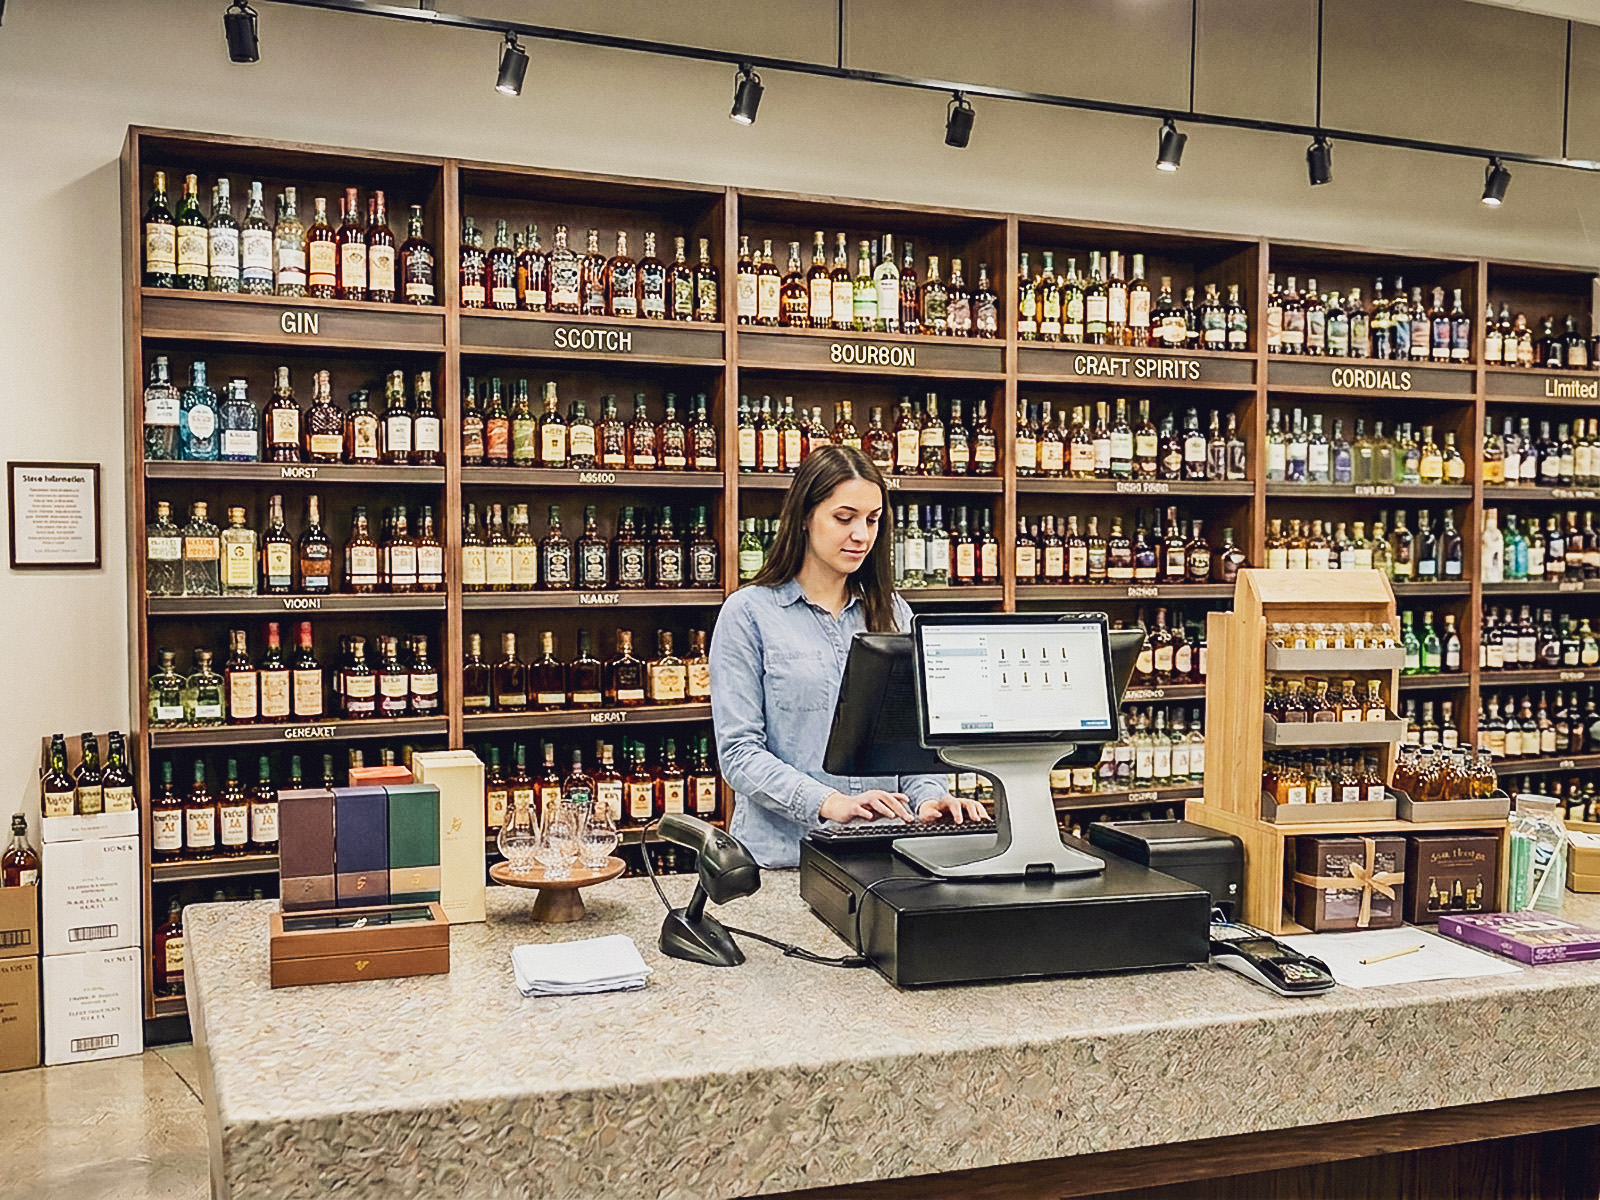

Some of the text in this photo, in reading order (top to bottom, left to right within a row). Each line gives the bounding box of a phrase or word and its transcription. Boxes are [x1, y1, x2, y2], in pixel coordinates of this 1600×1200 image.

[280, 311, 319, 334] GIN
[554, 328, 632, 351] SCOTCH
[1074, 355, 1200, 380] CRAFT SPIRITS
[1331, 368, 1411, 390] CORDIALS
